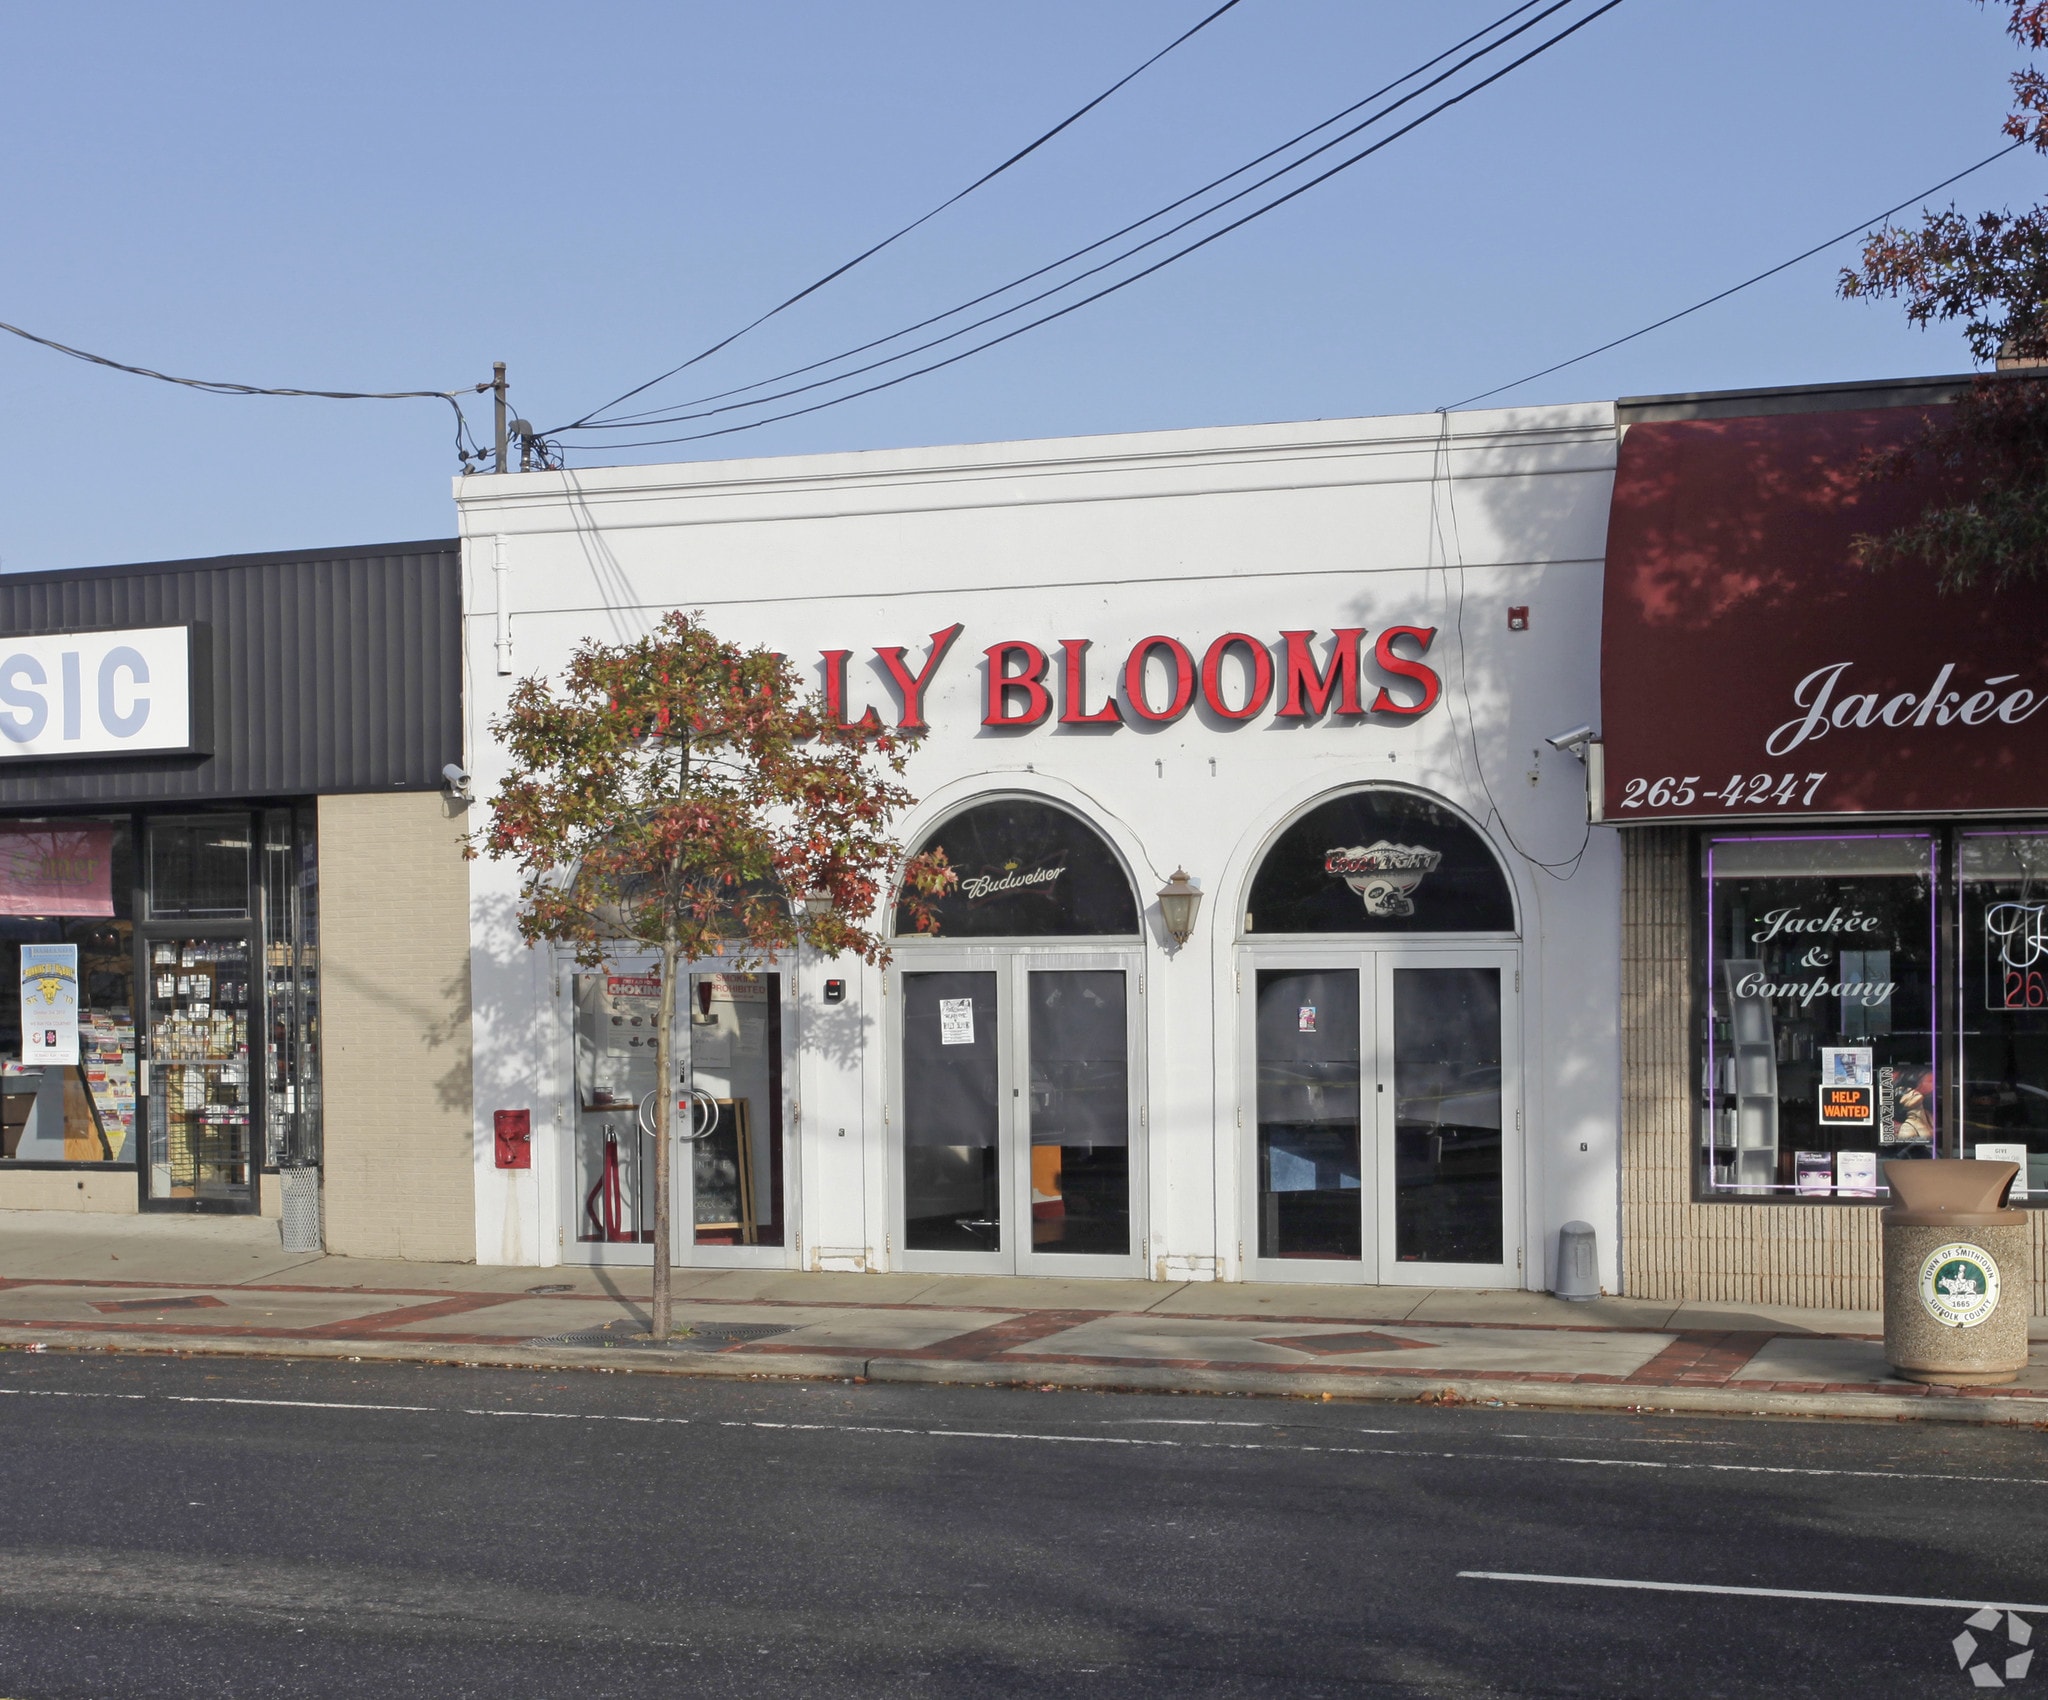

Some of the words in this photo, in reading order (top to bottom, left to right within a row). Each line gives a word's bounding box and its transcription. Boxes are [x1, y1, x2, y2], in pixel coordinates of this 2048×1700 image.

[980, 624, 1442, 727] BLOOMS
[0, 645, 151, 744] SIC
[1620, 771, 1828, 808] 265-4247
[1377, 853, 1438, 870] LIGHT
[961, 867, 1067, 899] Budweiser
[1800, 945, 1833, 968] &
[711, 984, 766, 994] PROHIBITED
[1735, 971, 1899, 1008] Company
[1831, 1091, 1861, 1103] HELP
[1880, 1066, 1895, 1143] BRAZILIAN
[1823, 1105, 1869, 1118] WANTED
[1924, 1258, 1941, 1281] TOWN
[1941, 1250, 1953, 1260] OF
[1955, 1248, 1995, 1279] SMITHTOWN
[1929, 1298, 1959, 1321] SUFFOLK
[1964, 1299, 1992, 1321] COUNTY
[1952, 1300, 1971, 1308] 1665
